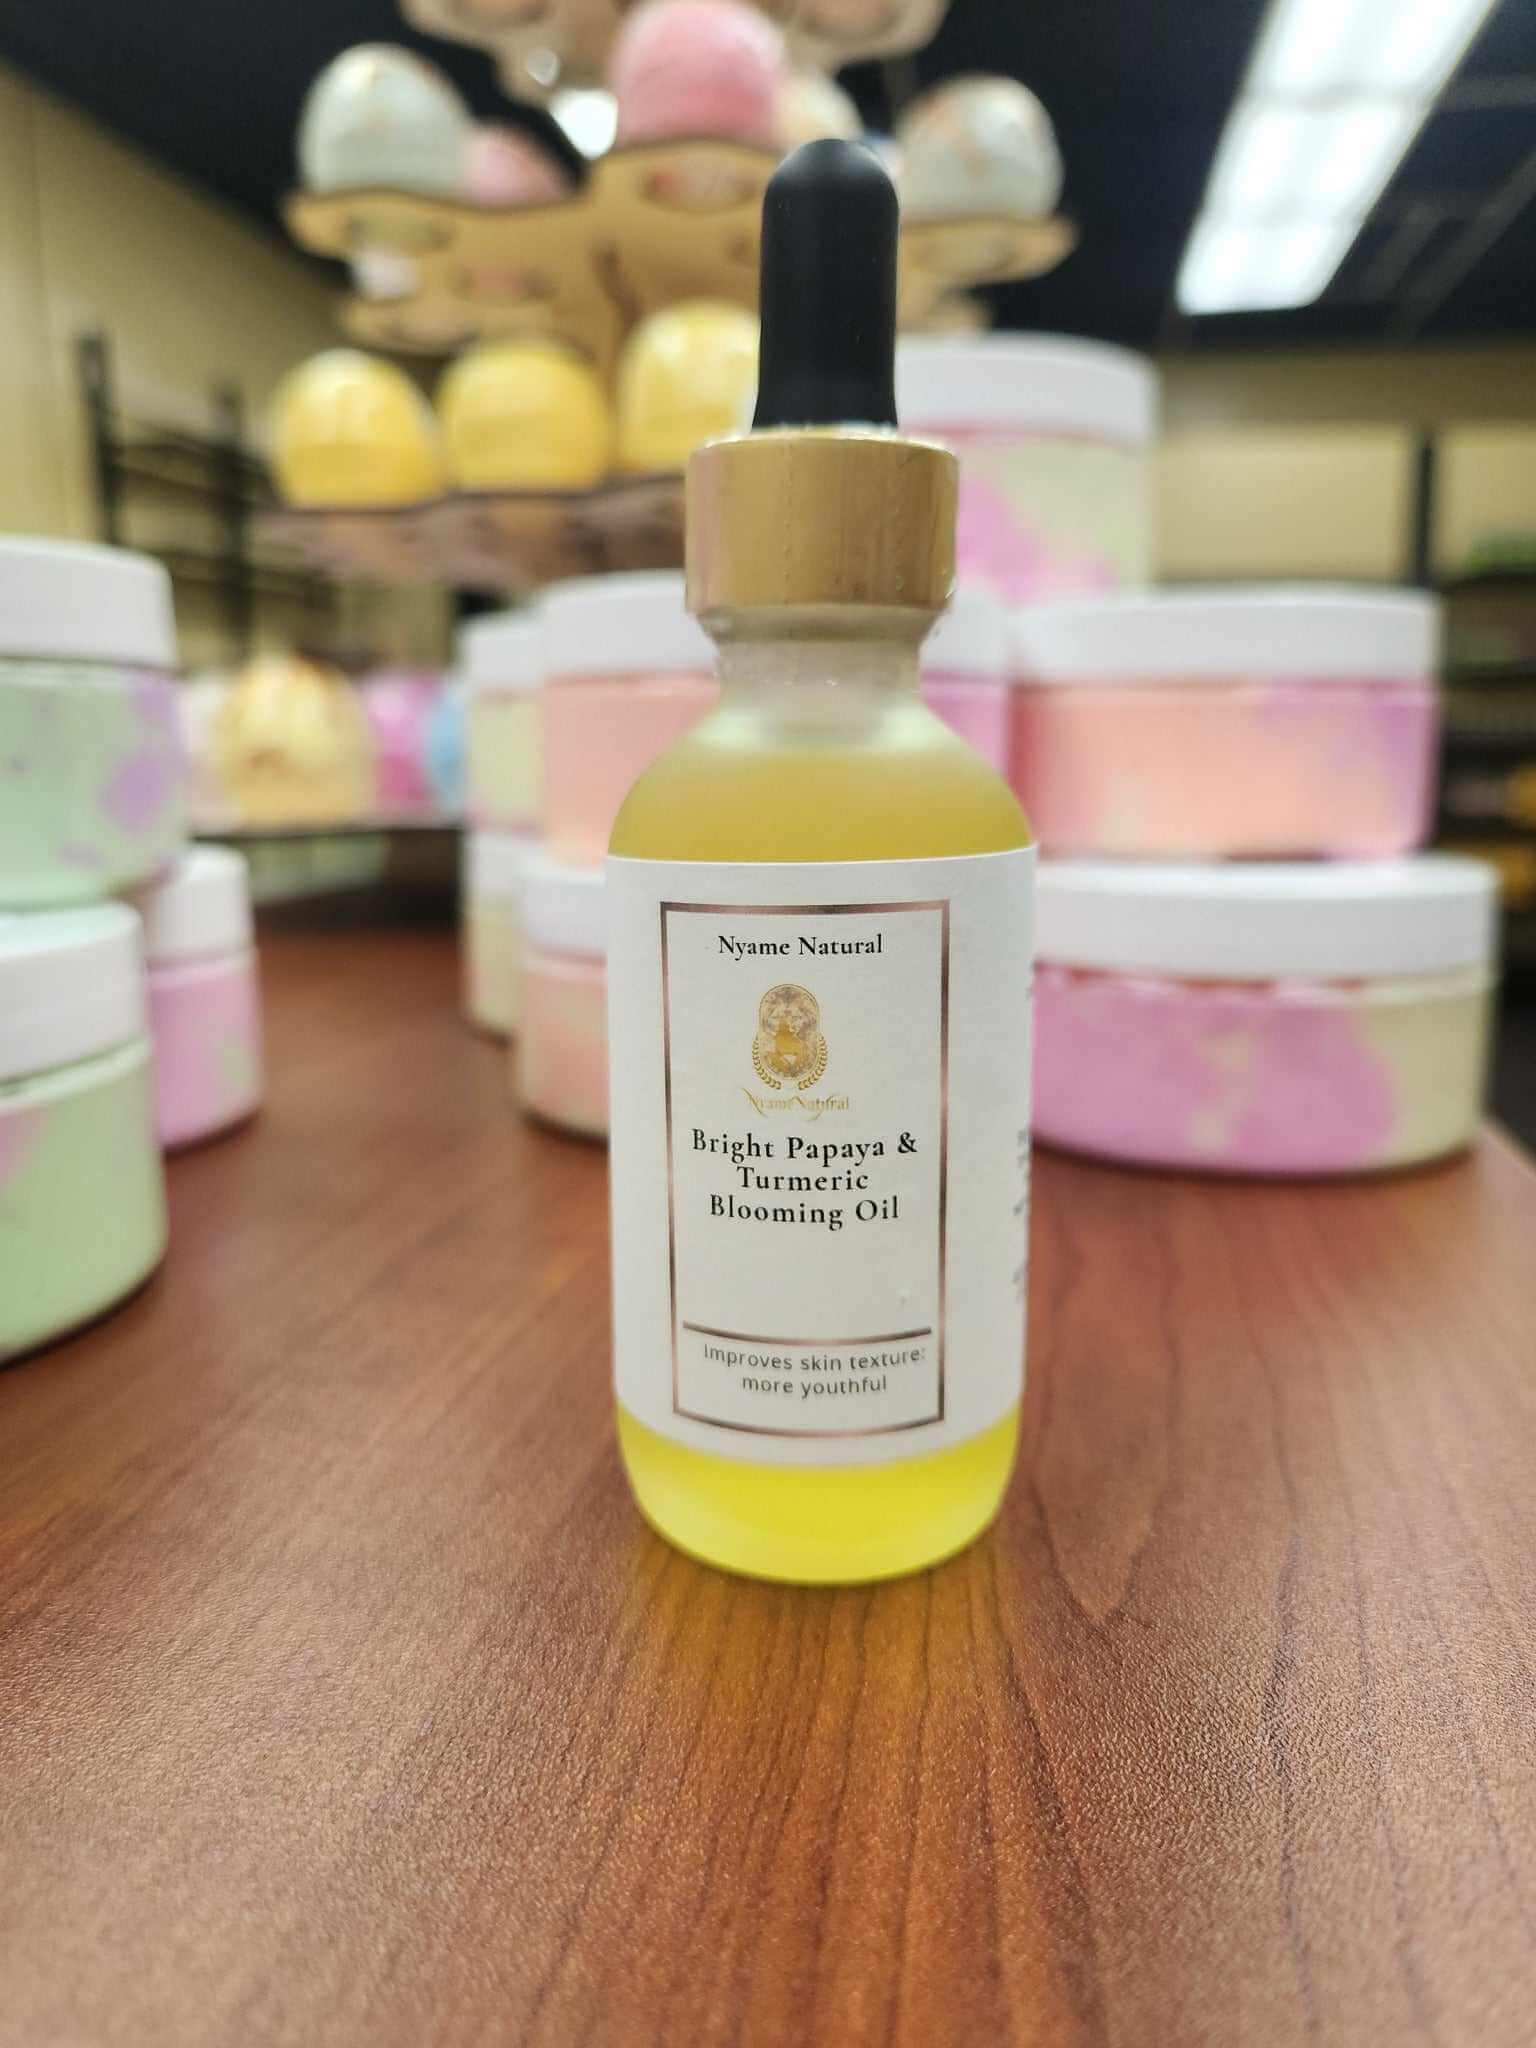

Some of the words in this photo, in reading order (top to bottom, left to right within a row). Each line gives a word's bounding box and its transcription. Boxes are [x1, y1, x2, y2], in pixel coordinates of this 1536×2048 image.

[718, 935, 791, 961] Nyame
[798, 934, 883, 956] Natural
[692, 1129, 775, 1164] Bright
[787, 1135, 885, 1167] Papaya
[897, 1132, 918, 1153] &
[736, 1166, 869, 1191] Turmeric
[710, 1195, 843, 1231] Blooming
[855, 1197, 899, 1220] Oil
[704, 1343, 793, 1370] Improves
[800, 1354, 842, 1371] skin
[742, 1376, 794, 1393] more
[800, 1375, 887, 1399] youthful
